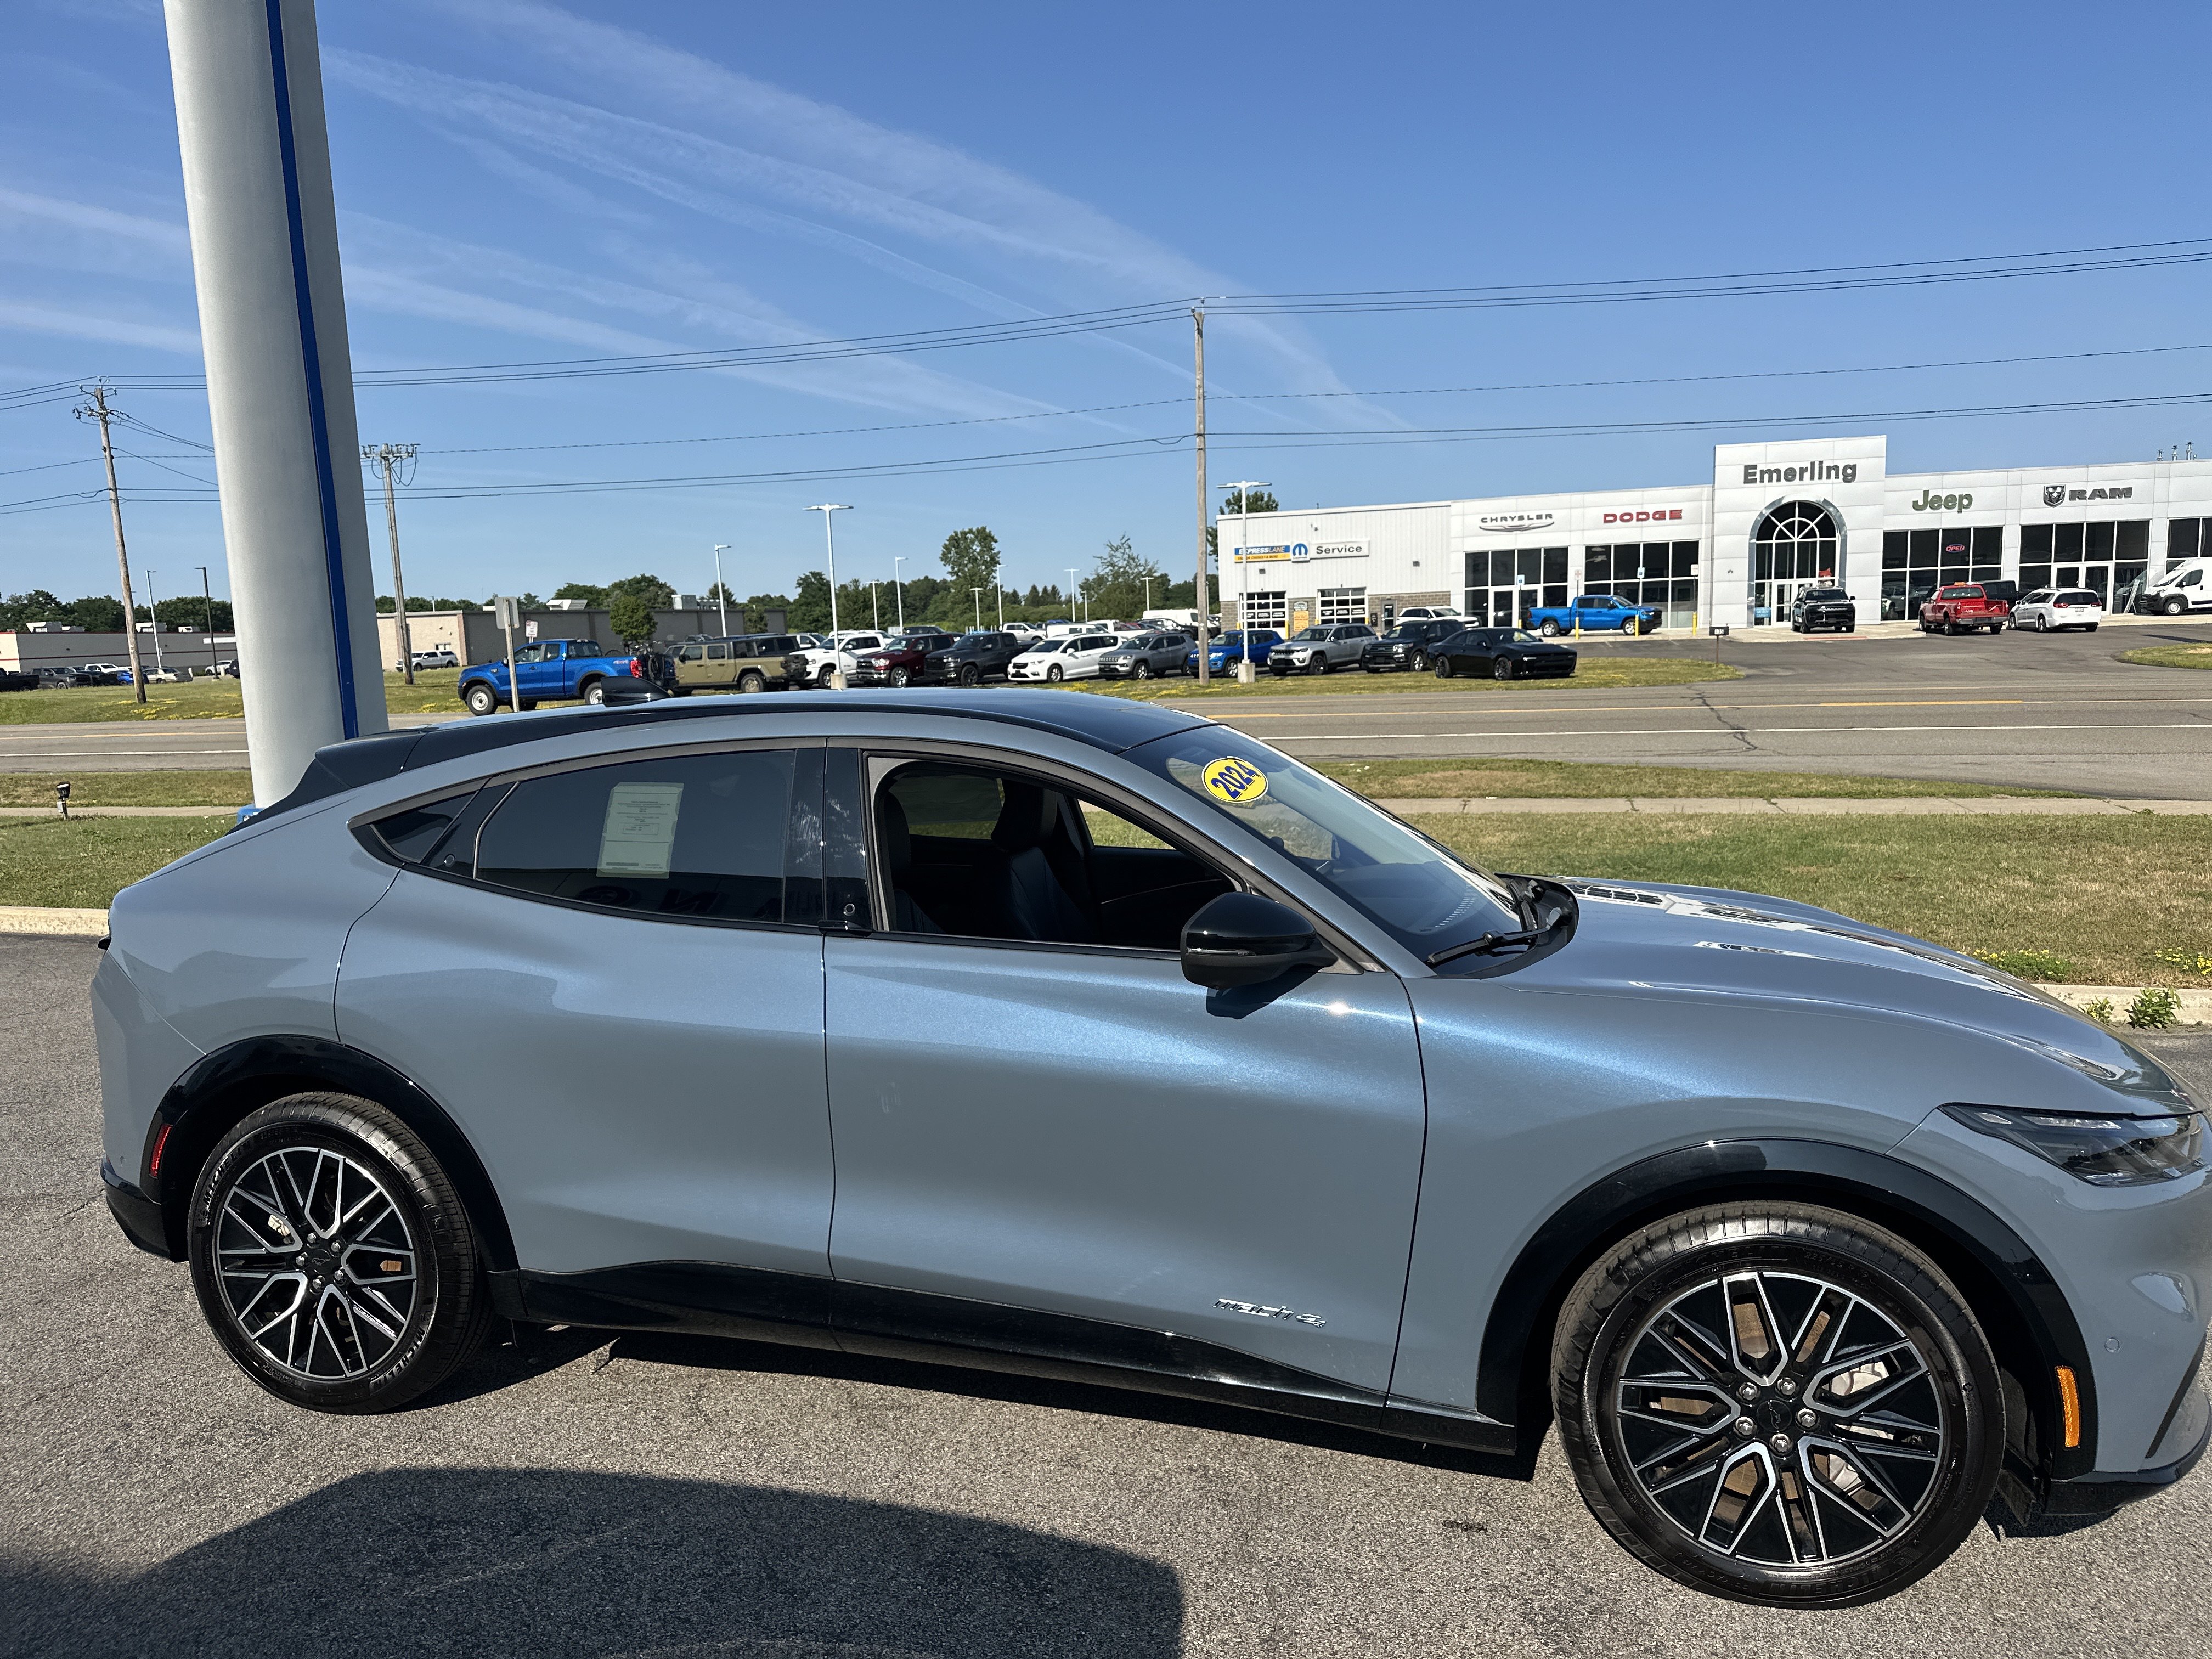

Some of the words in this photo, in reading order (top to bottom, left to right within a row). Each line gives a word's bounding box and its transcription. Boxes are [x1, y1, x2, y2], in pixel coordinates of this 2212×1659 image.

[1743, 460, 1857, 484] Emerling
[1912, 490, 1973, 514] Jeep
[2069, 487, 2133, 501] RAM
[1480, 513, 1553, 523] CHRYSLER
[1603, 510, 1683, 524] DODGE
[1316, 544, 1363, 554] Service
[1210, 760, 1259, 800] 2024
[373, 1325, 426, 1391] MICHELIN
